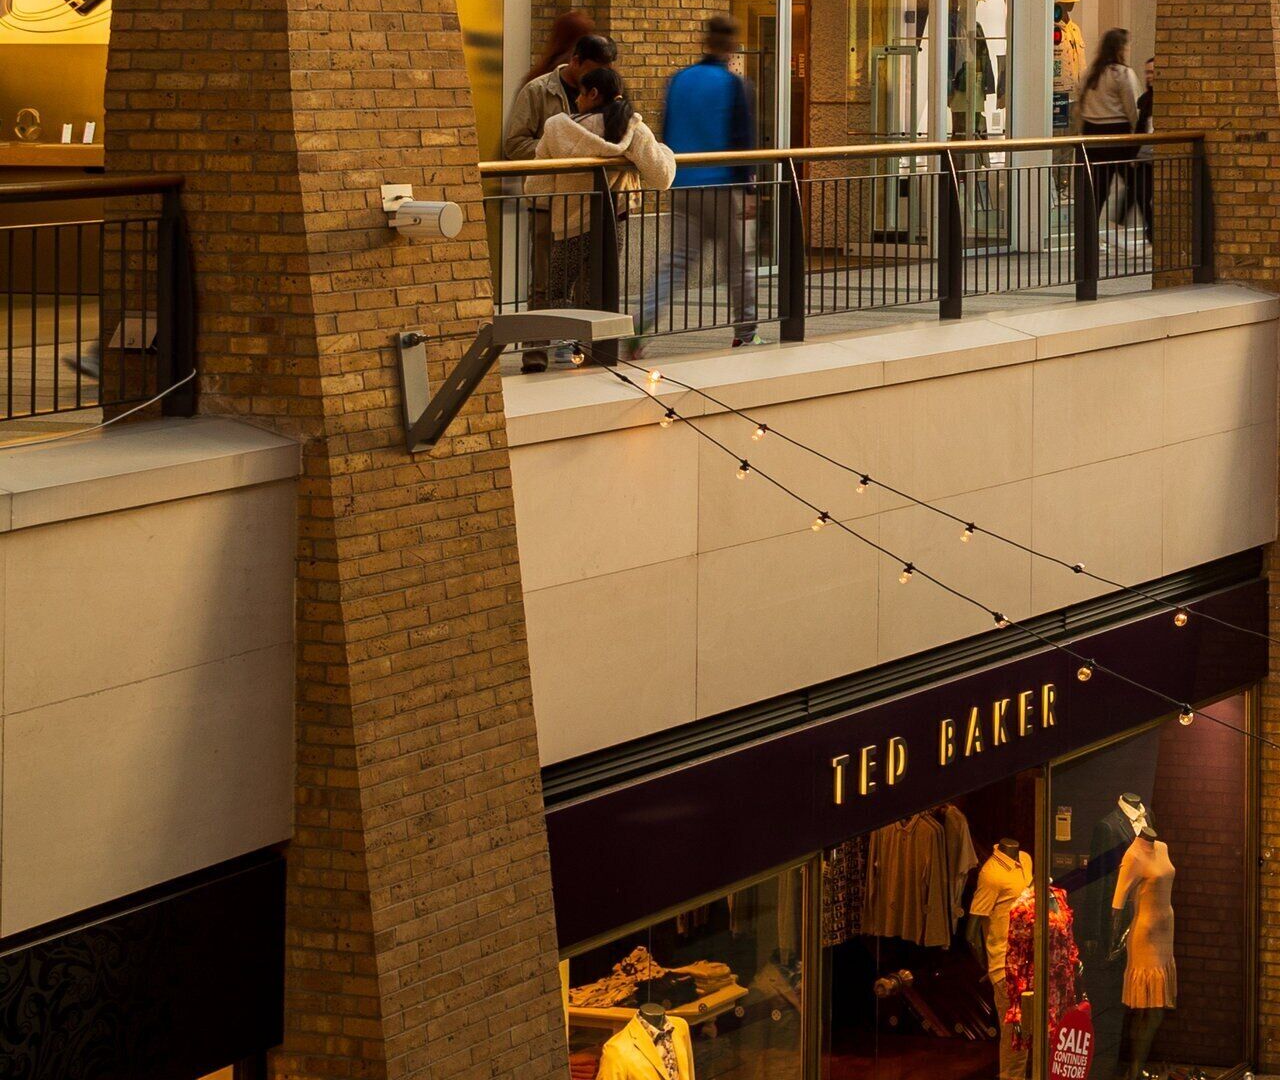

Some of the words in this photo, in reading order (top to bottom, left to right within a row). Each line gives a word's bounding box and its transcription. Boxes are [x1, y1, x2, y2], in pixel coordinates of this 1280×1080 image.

[832, 736, 908, 804] TED
[939, 683, 1058, 766] BAKER
[1057, 1027, 1091, 1056] SALE
[1052, 1060, 1087, 1079] IN-STORE
[1054, 1050, 1088, 1067] CONTINUES
